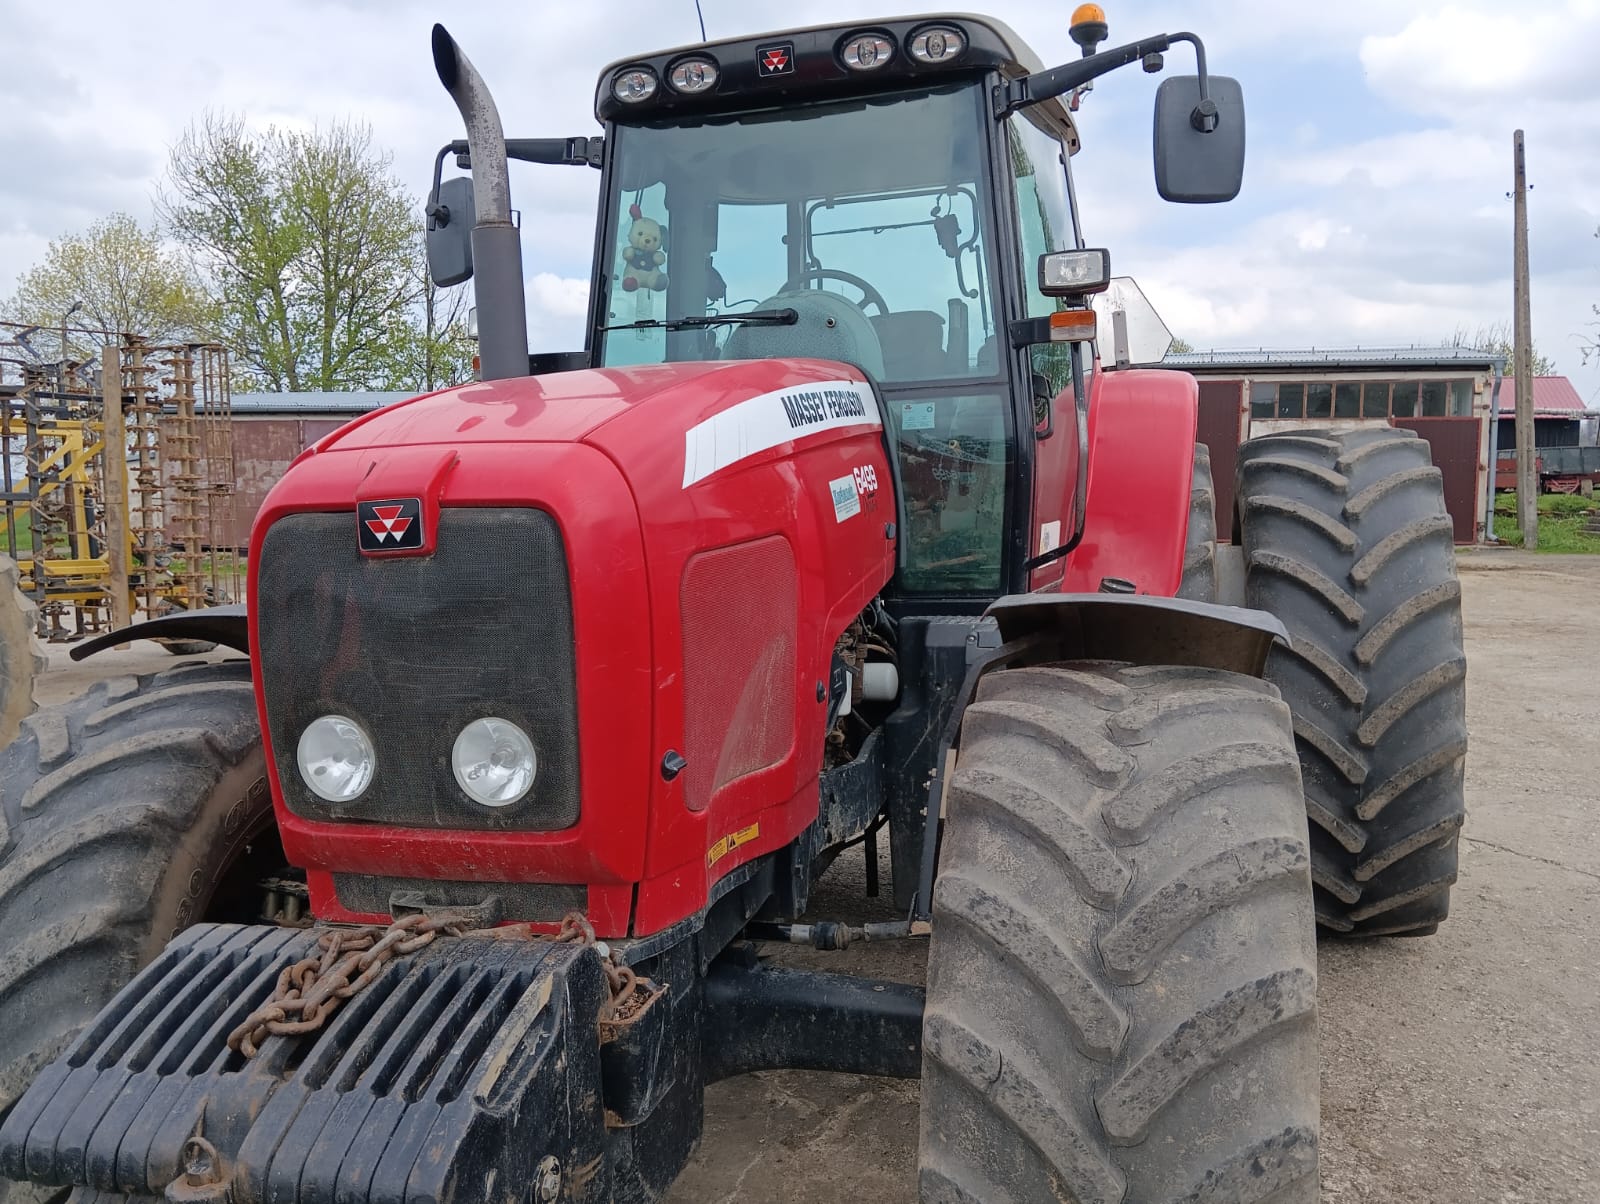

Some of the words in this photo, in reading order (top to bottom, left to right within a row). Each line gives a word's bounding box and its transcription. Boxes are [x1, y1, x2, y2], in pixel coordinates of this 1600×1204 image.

[780, 391, 828, 428] MASSEY
[823, 390, 866, 419] FERGUSON
[853, 464, 878, 494] 6499
